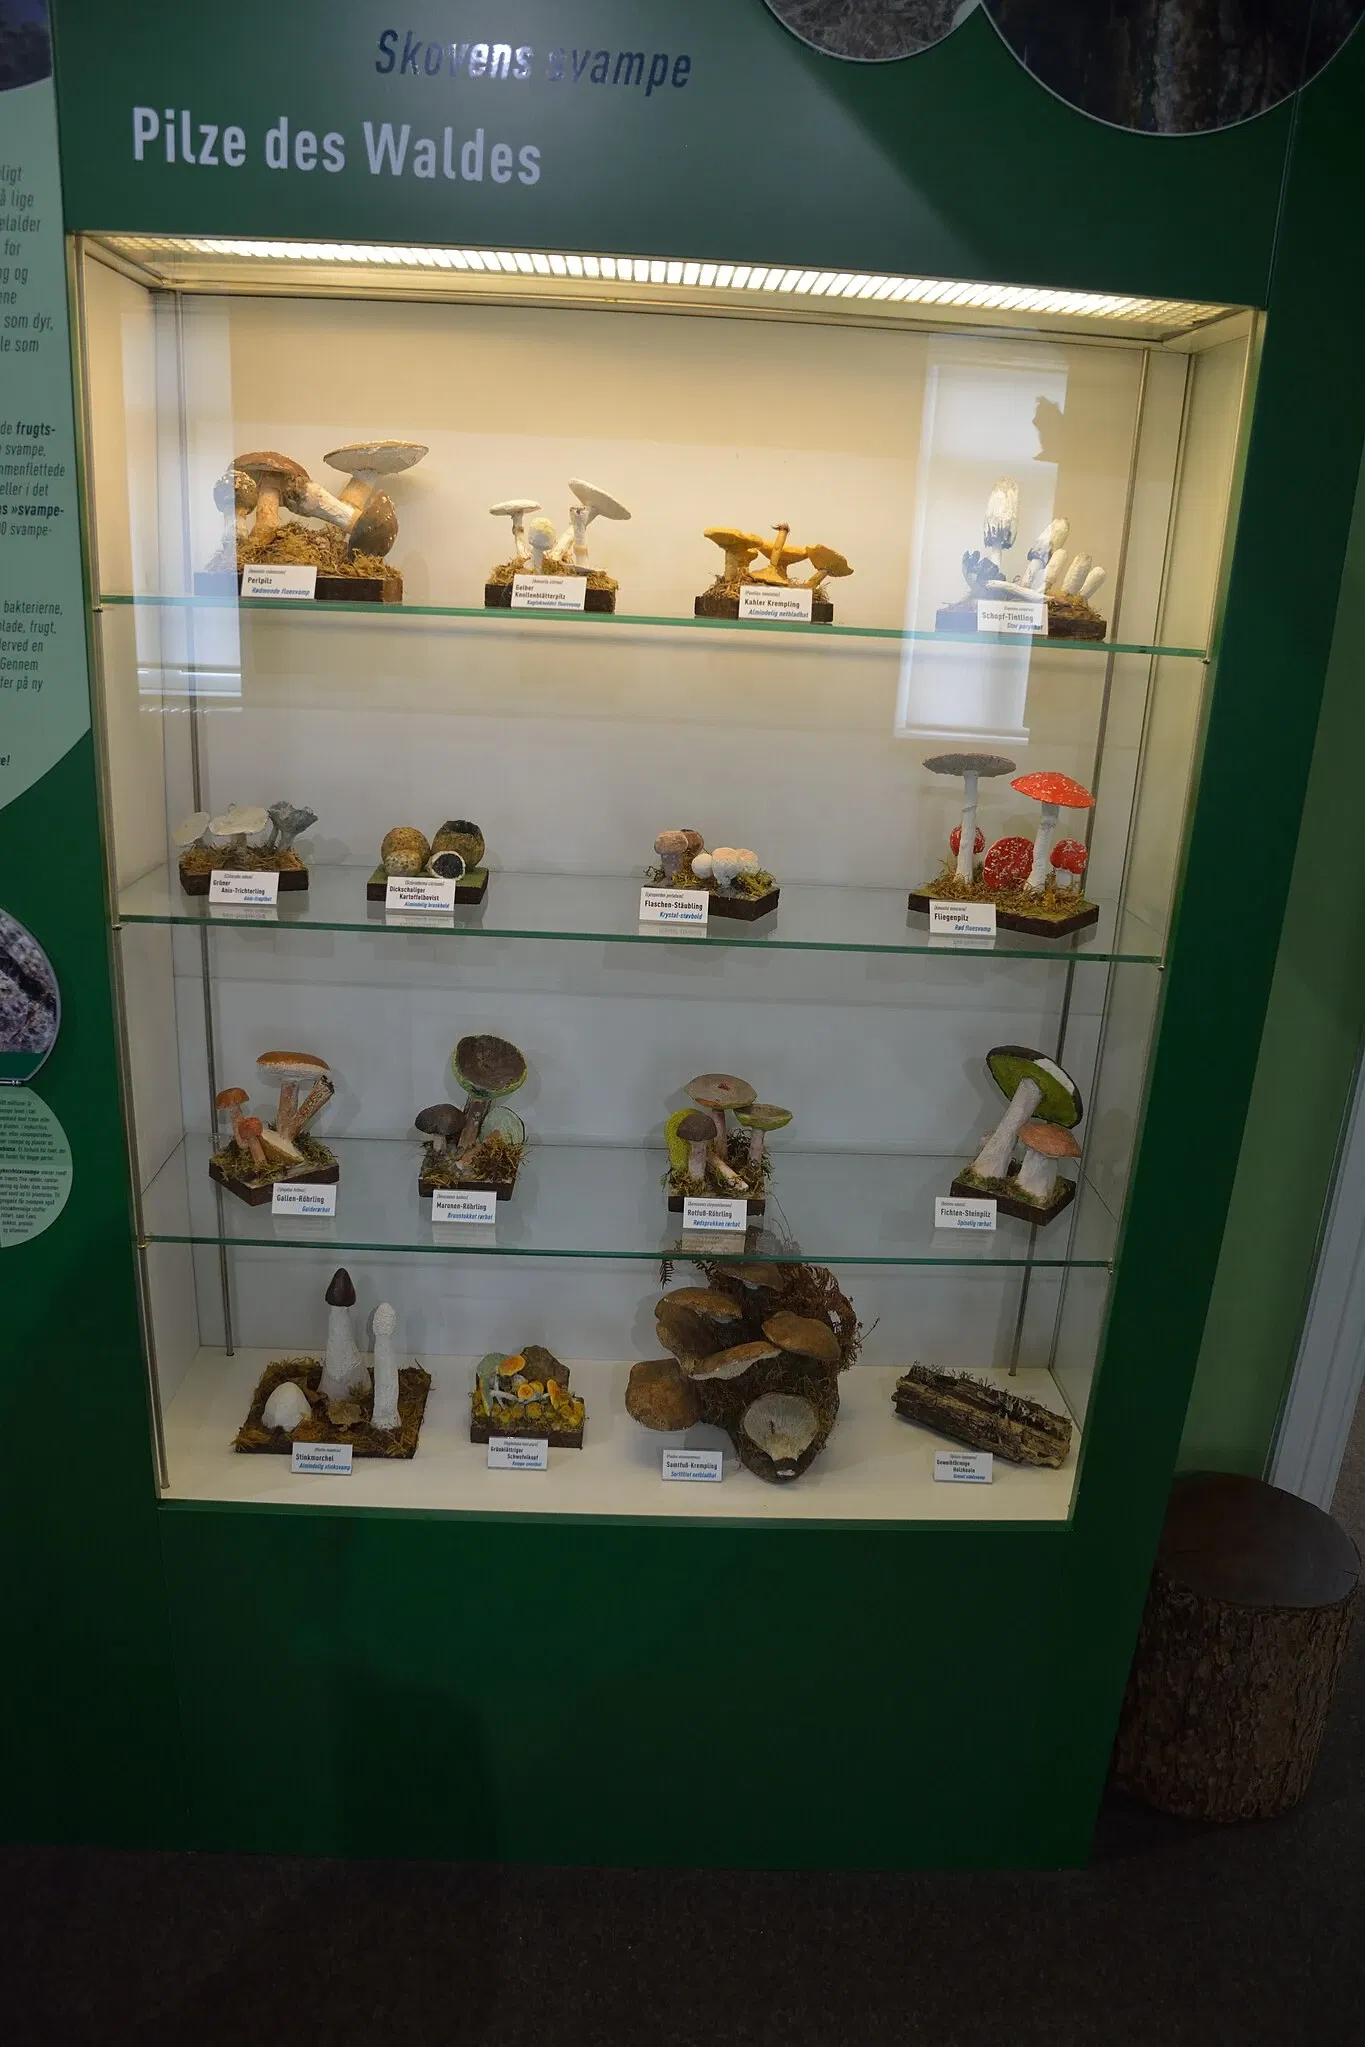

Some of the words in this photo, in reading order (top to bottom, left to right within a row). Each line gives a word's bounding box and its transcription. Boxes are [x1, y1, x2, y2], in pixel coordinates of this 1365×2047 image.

[375, 28, 532, 81] Skovens
[546, 46, 691, 97] svampe
[133, 106, 246, 168] Pilze
[265, 116, 346, 173] des
[363, 121, 541, 185] Waldes
[0, 164, 21, 186] ligt
[11, 189, 34, 211] lige
[4, 238, 21, 256] for
[14, 268, 28, 285] og
[4, 315, 28, 328] som
[33, 312, 54, 332] dyr,
[16, 339, 39, 352] som
[16, 421, 56, 438] frugts-
[33, 484, 48, 496] det
[248, 576, 272, 584] Perlpilz
[4, 600, 63, 616] bakterierne,
[767, 600, 800, 609] Krempling
[982, 612, 1034, 622] Schopf-Tintling
[0, 620, 26, 634] lade,
[0, 638, 28, 652] erved
[32, 642, 44, 652] en
[0, 657, 38, 670] Gennem
[16, 676, 28, 692] på
[32, 679, 44, 692] ny
[644, 900, 703, 911] Flaschen-Stäubling
[934, 913, 968, 922] Fliegenpilz
[276, 1194, 324, 1204] Gallen-Röhrling
[436, 1202, 486, 1211] Maronen-Röhrling
[940, 1208, 990, 1218] Fichten-Steinpilz
[688, 1210, 732, 1218] Rotfuß-Röhrling
[296, 1454, 334, 1462] Stinkmorchel
[666, 1462, 718, 1470] Samtfuß-Krempling
